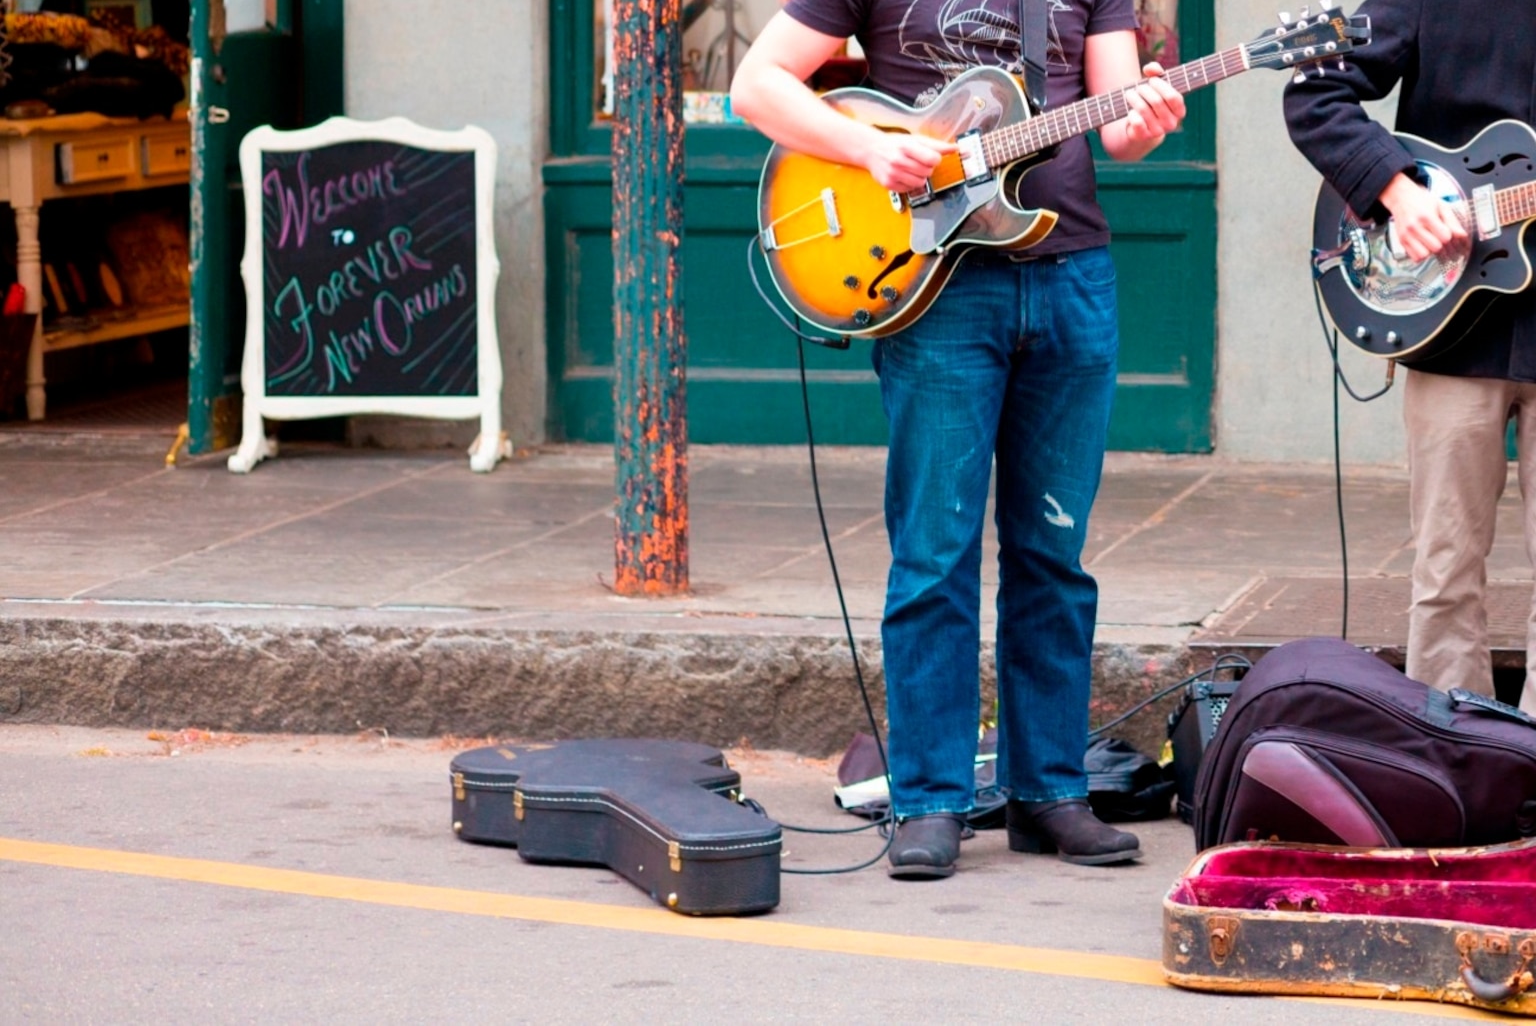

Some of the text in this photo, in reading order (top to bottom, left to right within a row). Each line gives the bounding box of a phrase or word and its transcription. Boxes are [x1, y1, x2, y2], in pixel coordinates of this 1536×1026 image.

[331, 228, 356, 247] TO
[268, 226, 433, 388] FOREVER
[324, 317, 372, 393] NEW
